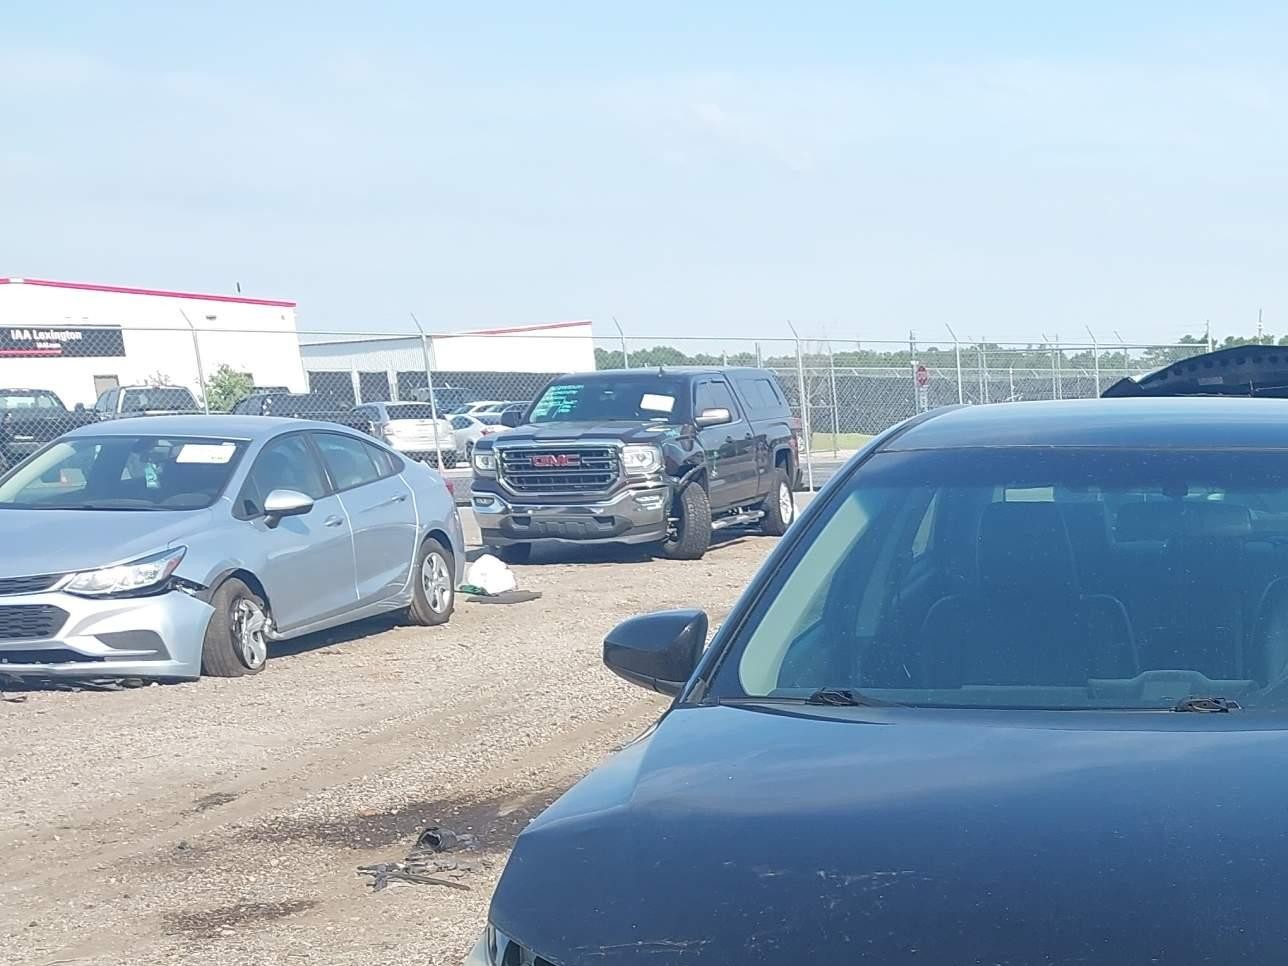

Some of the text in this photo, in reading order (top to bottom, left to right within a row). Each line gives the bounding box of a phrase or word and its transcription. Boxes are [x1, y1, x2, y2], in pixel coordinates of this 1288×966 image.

[11, 329, 82, 342] IAA Lexington
[532, 453, 580, 466] GMC
